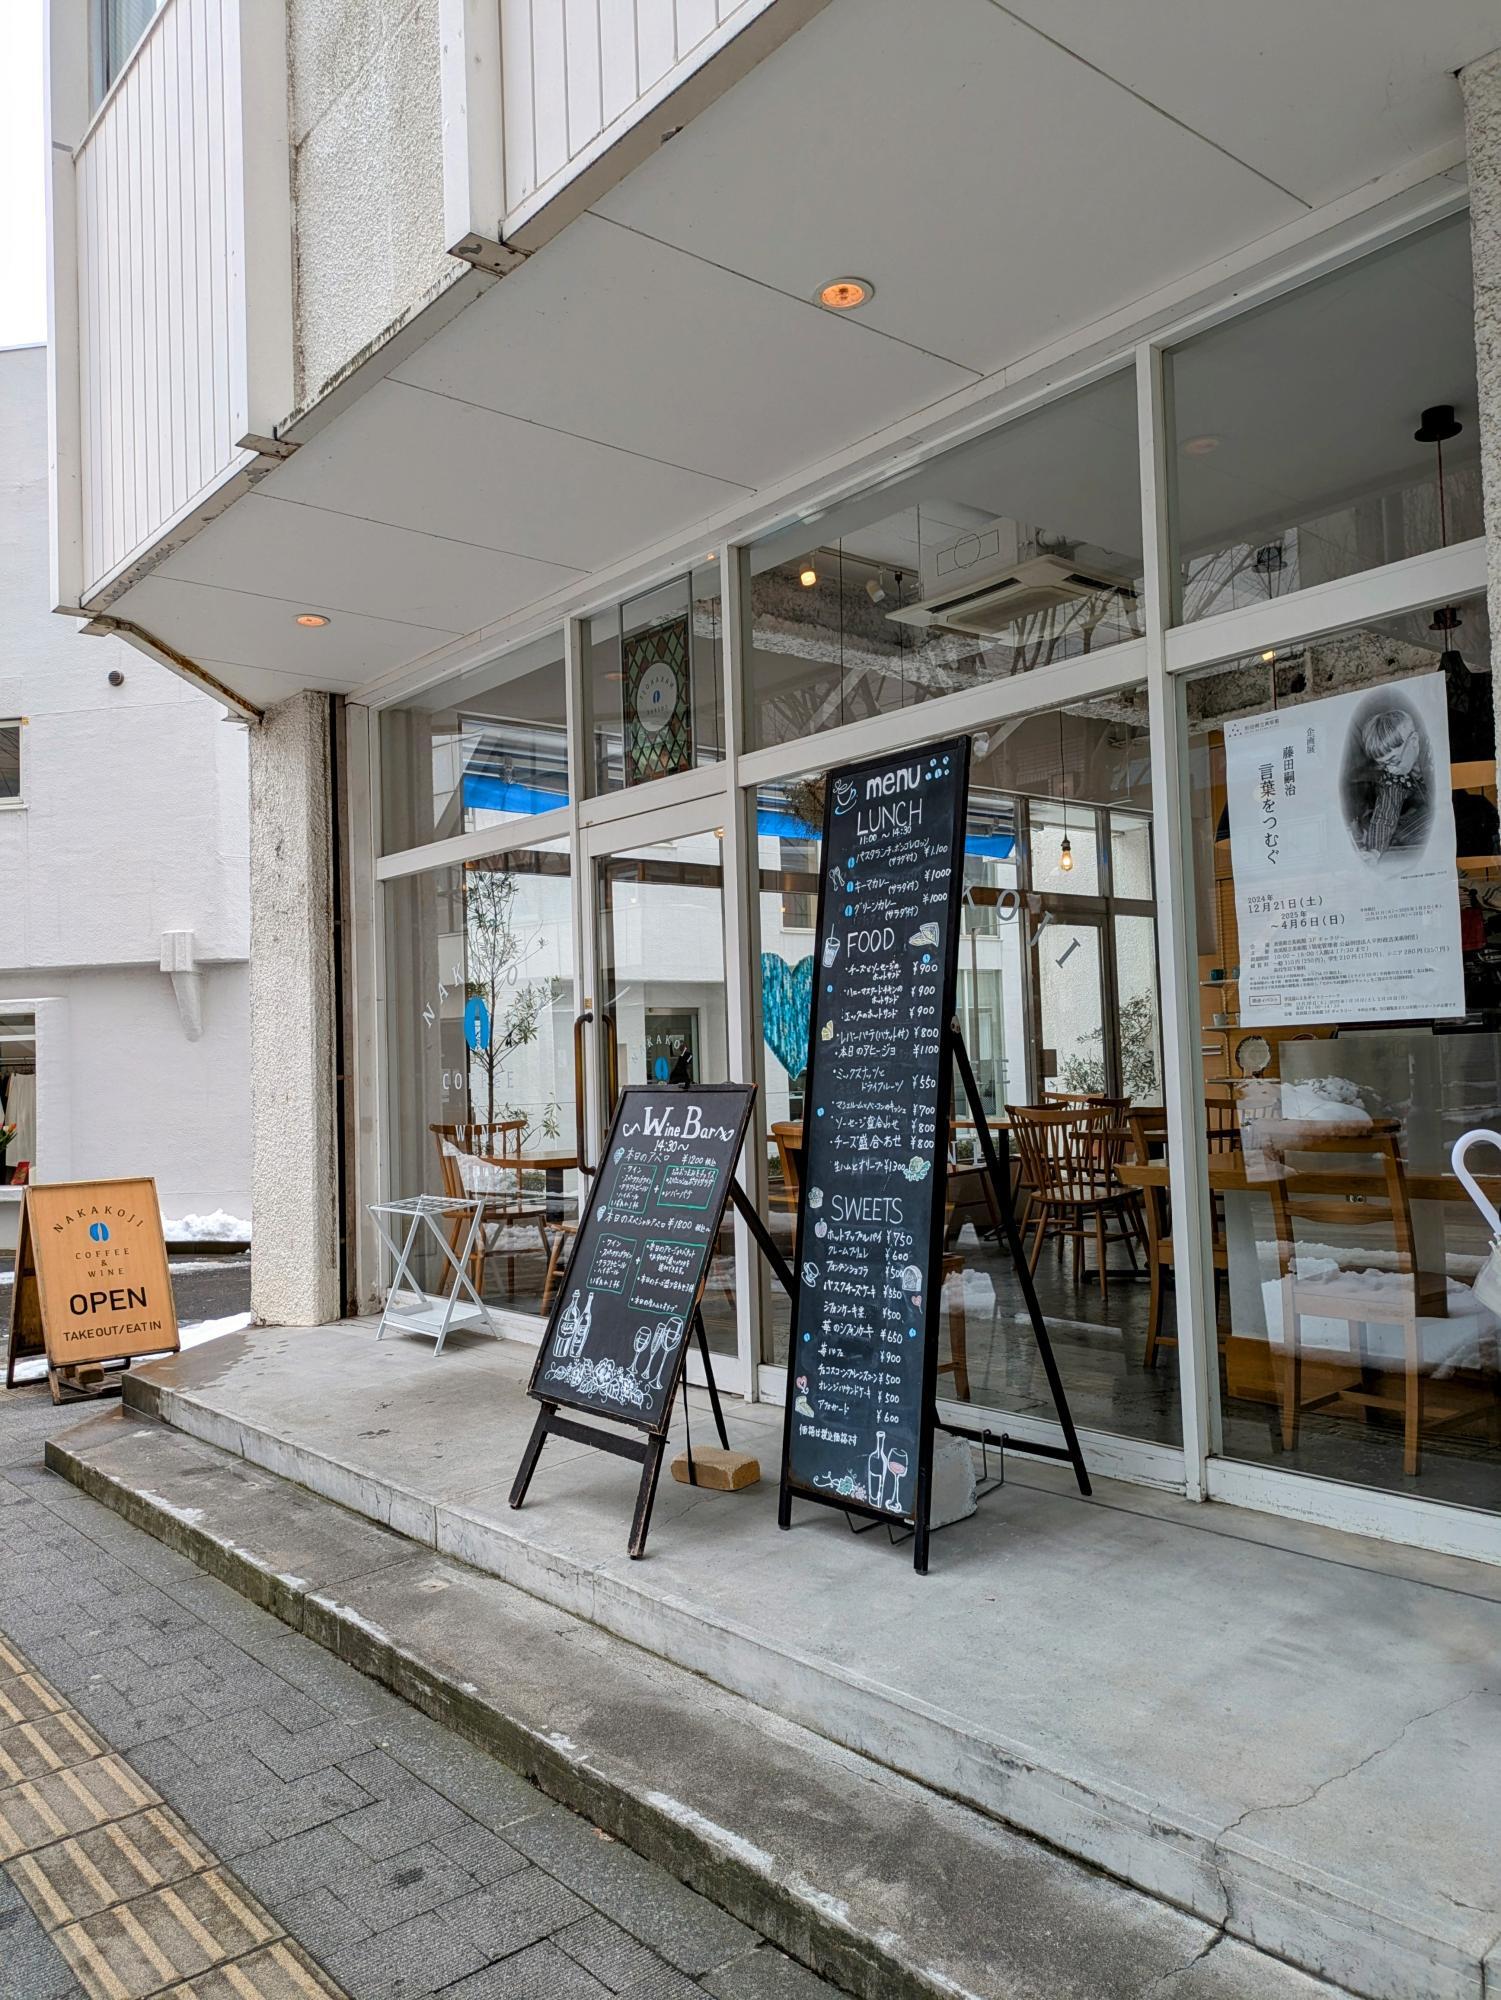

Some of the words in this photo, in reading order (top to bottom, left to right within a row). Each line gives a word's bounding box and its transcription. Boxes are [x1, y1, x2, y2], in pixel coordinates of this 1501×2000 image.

[1306, 727, 1316, 754] 企画展
[1282, 745, 1296, 797] 藤田嗣治
[866, 765, 921, 800] menu
[857, 798, 923, 836] LUNCH
[1259, 762, 1280, 865] 言葉をつむぐ
[924, 868, 952, 882] ¥1000
[855, 878, 890, 894] キーマカレー
[922, 892, 948, 905] ¥1000
[1247, 894, 1273, 904] 2024年
[854, 899, 897, 916] グリーンカレー
[1281, 911, 1307, 920] 2025年
[847, 927, 895, 958] FOOD
[913, 961, 939, 976] ¥900
[911, 985, 936, 998] ¥900
[909, 1005, 935, 1019] ¥900
[913, 1026, 939, 1039] ¥800
[837, 1043, 896, 1059] 本日のアヒージョ
[913, 1044, 940, 1059] ¥1100
[861, 1080, 905, 1093] ドライフルーツ
[912, 1074, 937, 1090] ¥550
[913, 1103, 936, 1117] ¥700
[642, 1106, 681, 1138] Wine
[680, 1105, 716, 1140] Bar
[911, 1118, 936, 1134] ¥800
[834, 1133, 902, 1151] チーズ盛合わせ
[911, 1135, 935, 1150] ¥800
[624, 1147, 671, 1164] 本日のアペロ
[681, 1153, 704, 1166] ¥1200
[831, 1194, 904, 1225] SWEETS
[53, 1205, 144, 1233] NAKAKOJI
[667, 1217, 693, 1230] ¥1800
[886, 1229, 913, 1247] ¥750
[75, 1247, 130, 1260] COFFEE
[885, 1247, 910, 1262] ¥600
[101, 1259, 108, 1267] &
[88, 1267, 125, 1279] WINE
[883, 1284, 903, 1300] ¥550
[69, 1286, 148, 1316] OPEN
[882, 1307, 902, 1321] ¥500
[880, 1328, 903, 1345] ¥650
[880, 1350, 902, 1363] ¥900
[879, 1372, 901, 1386] ¥500
[878, 1390, 900, 1404] ¥500
[876, 1409, 900, 1424] ¥600
